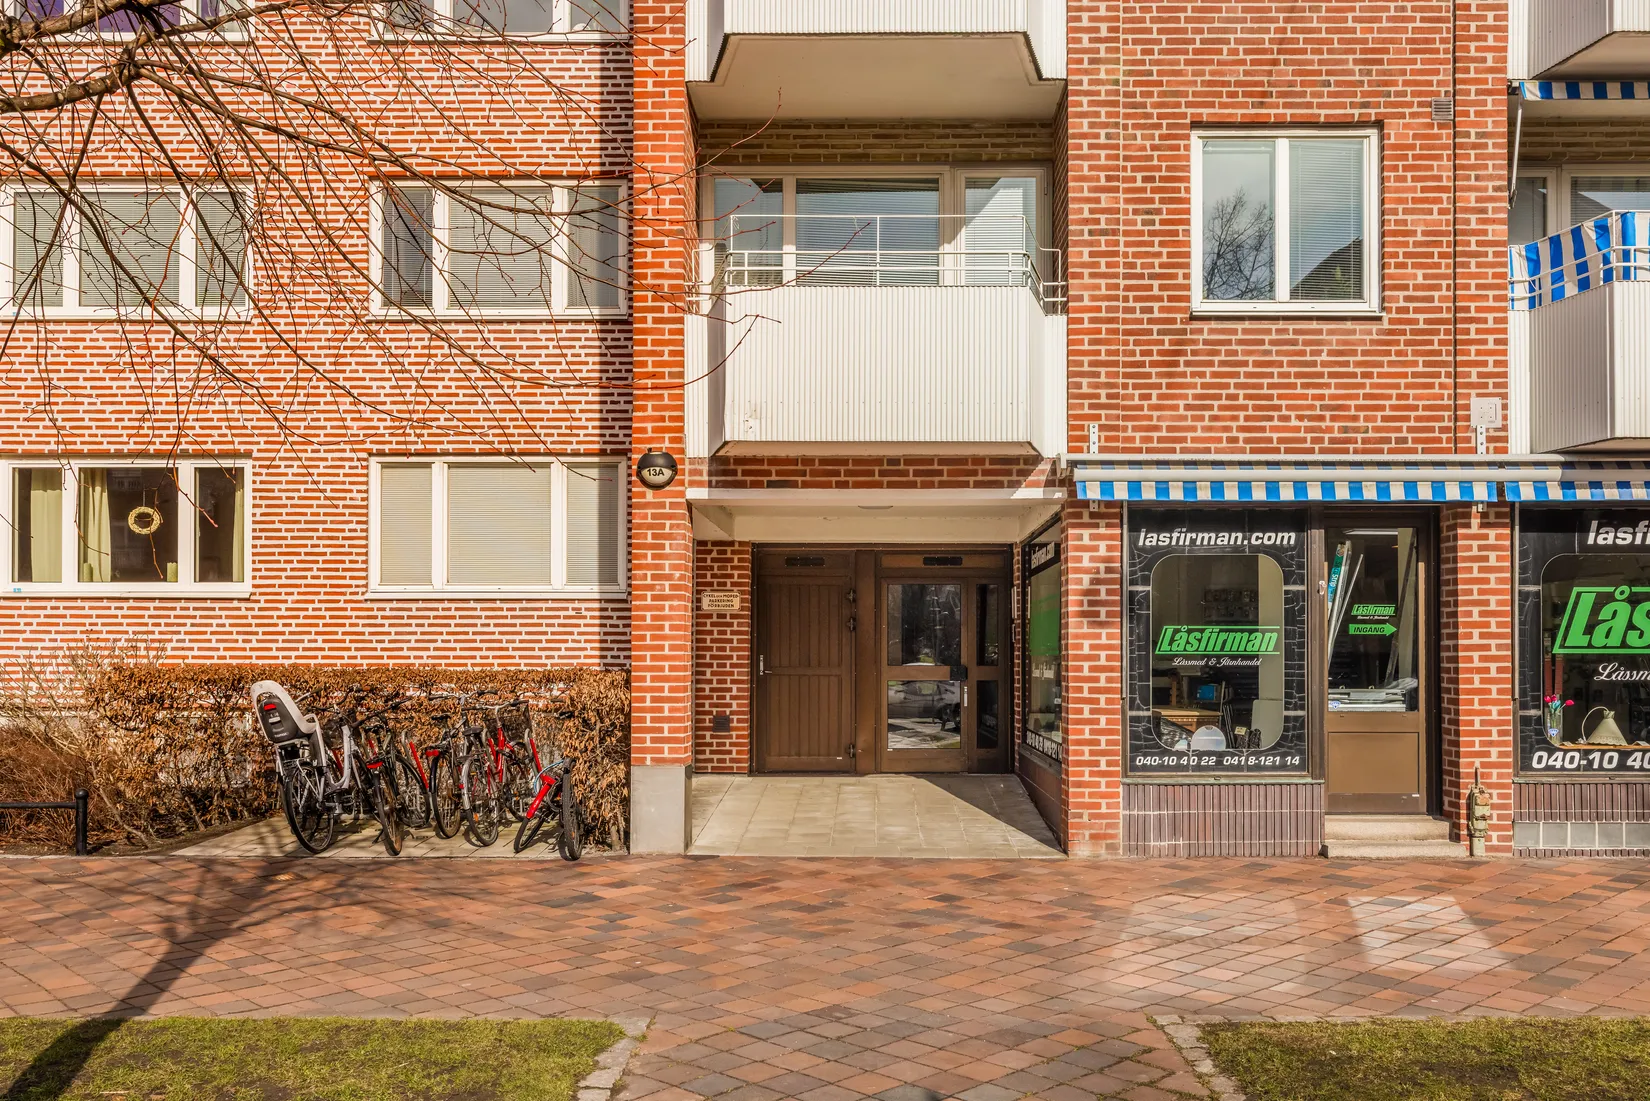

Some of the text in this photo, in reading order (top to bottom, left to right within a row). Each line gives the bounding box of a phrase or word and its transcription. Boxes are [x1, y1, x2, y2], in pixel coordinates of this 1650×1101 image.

[647, 468, 665, 477] 13A
[1138, 528, 1296, 546] lasfirman.com
[1159, 625, 1279, 652] Låsfirman
[1172, 657, 1208, 666] Låssmed
[1208, 658, 1217, 666] &
[1136, 756, 1300, 766] 040-10 40 22 0418-121 14
[1532, 751, 1619, 769] 040-10
